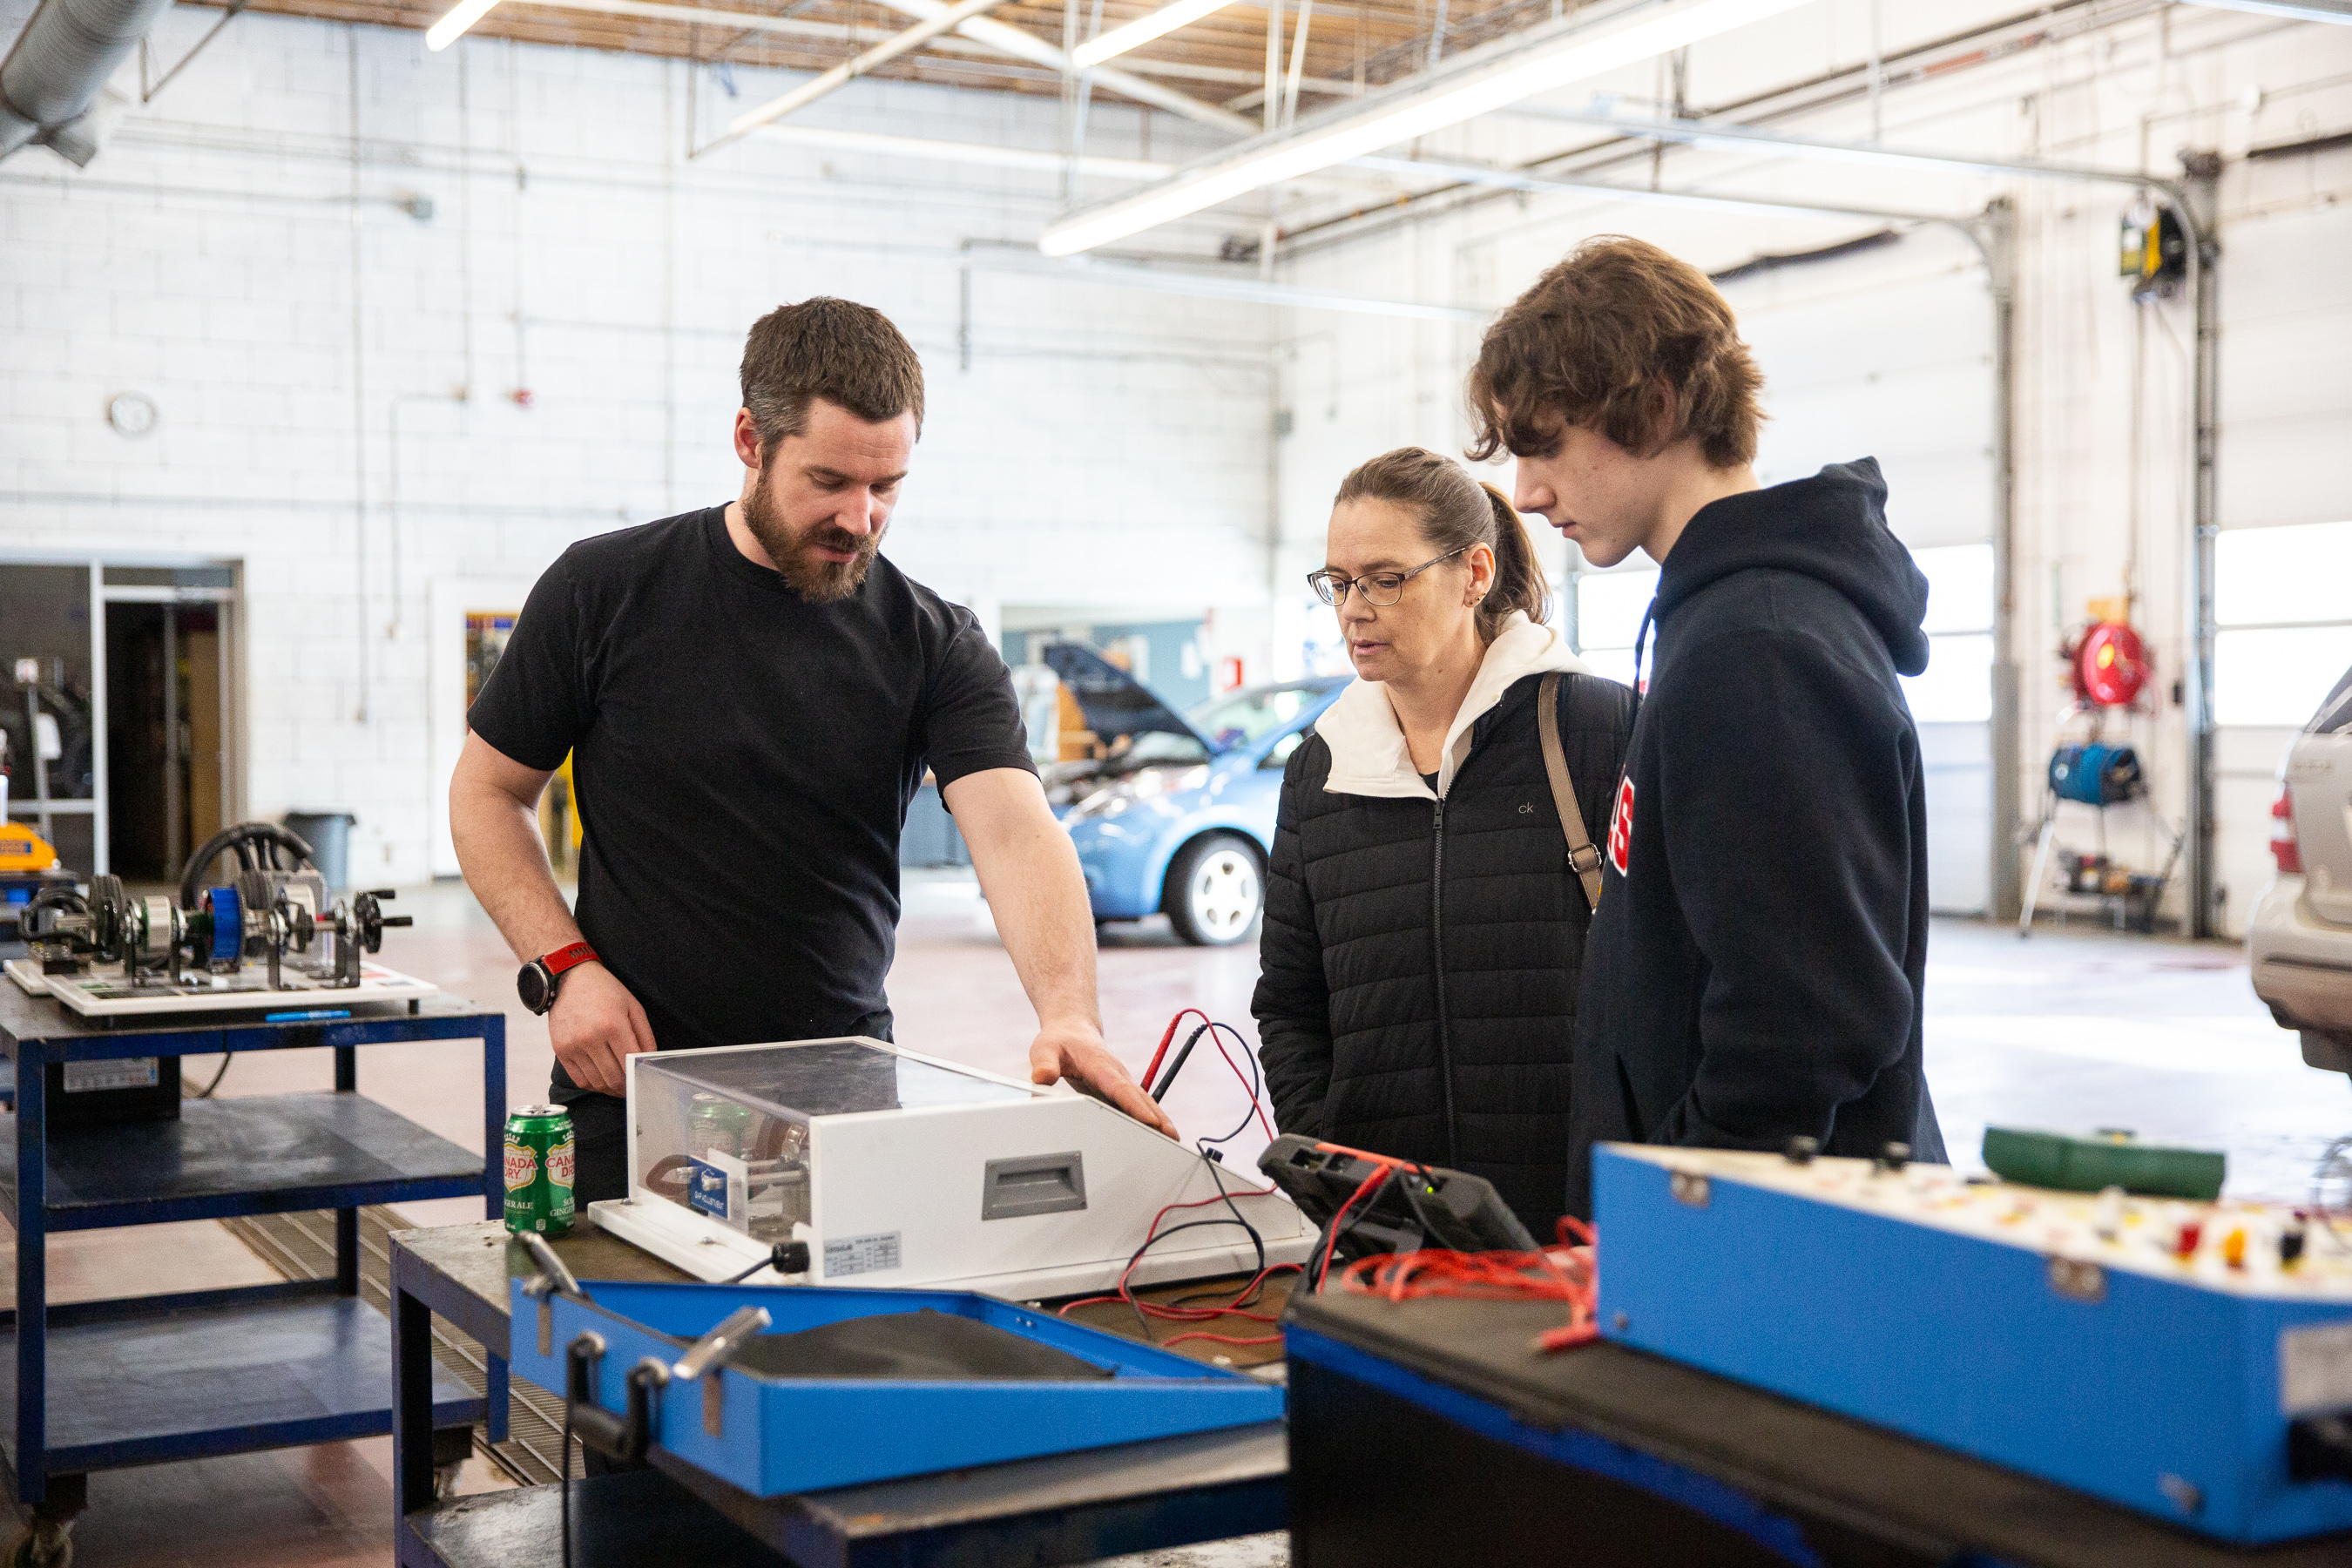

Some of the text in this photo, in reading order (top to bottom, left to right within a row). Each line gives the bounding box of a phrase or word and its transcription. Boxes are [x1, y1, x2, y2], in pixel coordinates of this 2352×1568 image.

[1518, 801, 1533, 814] ck
[1608, 774, 1635, 877] S
[504, 1156, 537, 1169] NADA
[545, 1152, 575, 1168] CANA
[561, 1164, 575, 1178] DR
[517, 1201, 534, 1210] ALE
